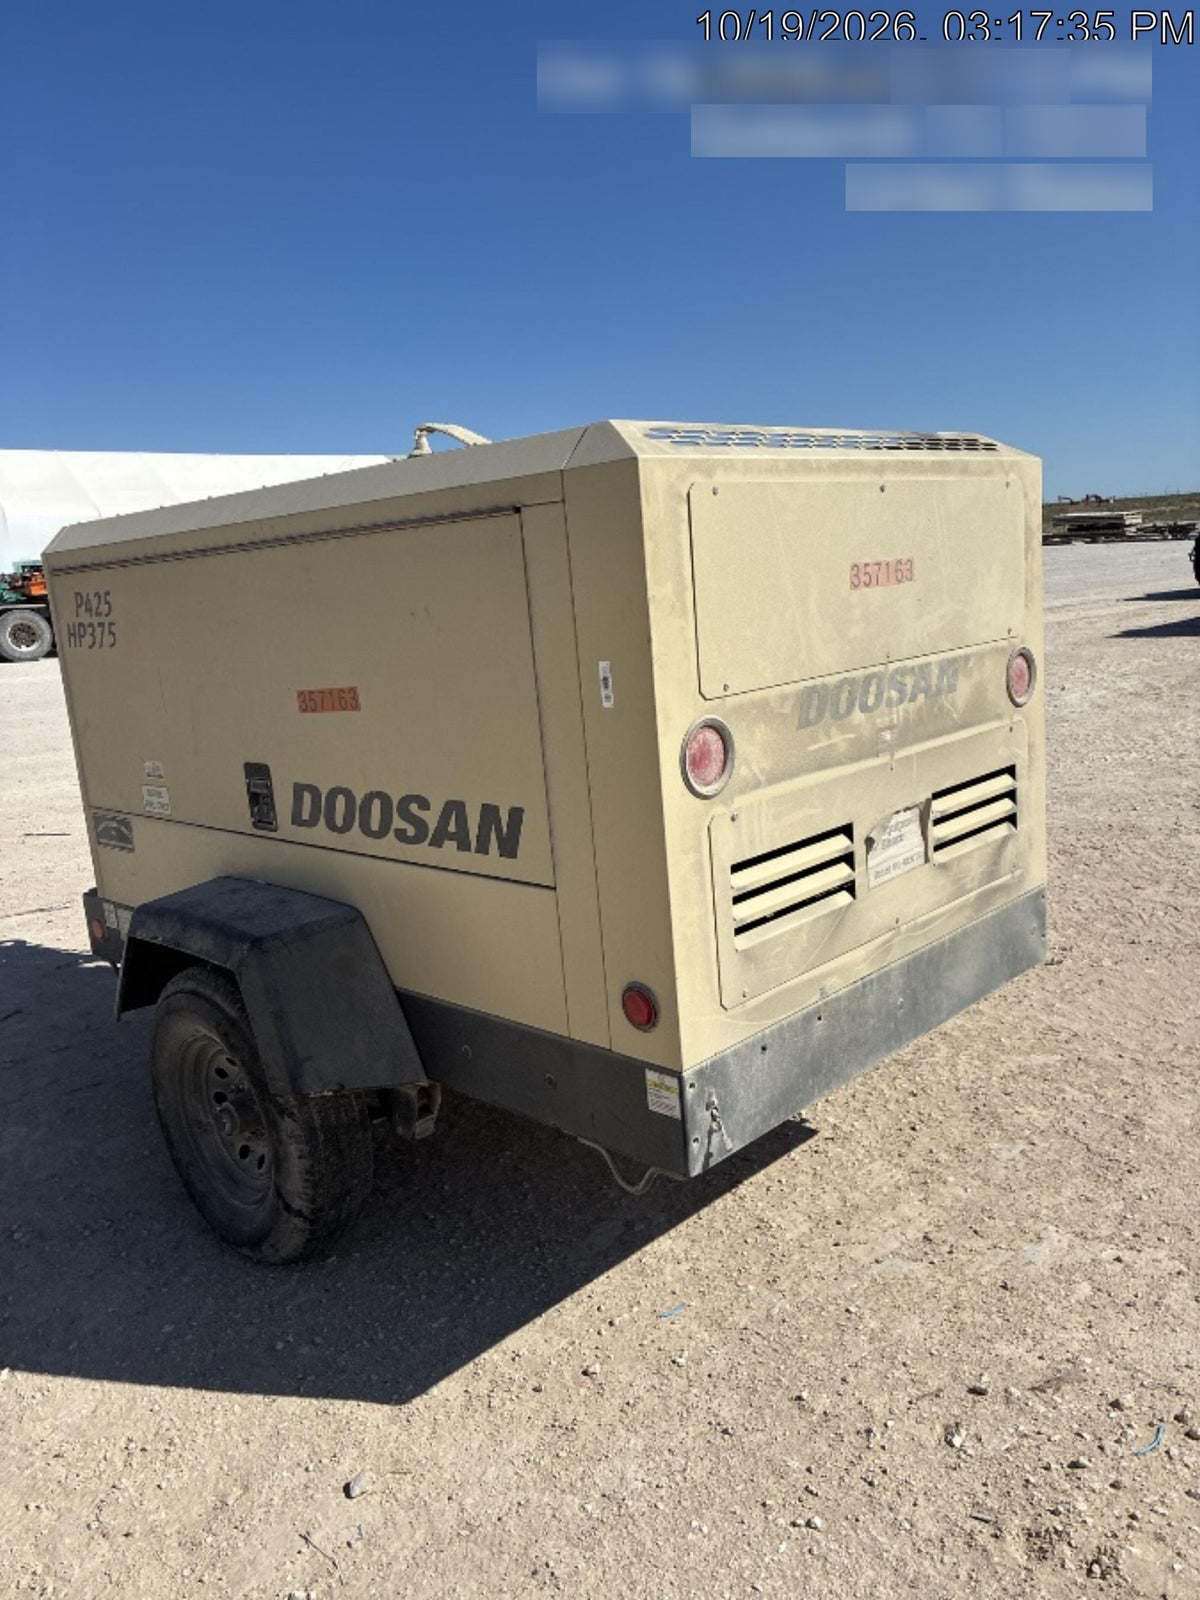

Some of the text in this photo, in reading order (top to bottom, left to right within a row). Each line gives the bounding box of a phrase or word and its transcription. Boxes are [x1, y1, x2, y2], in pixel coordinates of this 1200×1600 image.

[850, 559, 913, 588] 357163
[74, 590, 112, 617] P425
[67, 622, 116, 649] HP375
[297, 686, 360, 713] 357163
[796, 656, 968, 731] DOOSAN
[291, 782, 525, 859] DOOSAN
